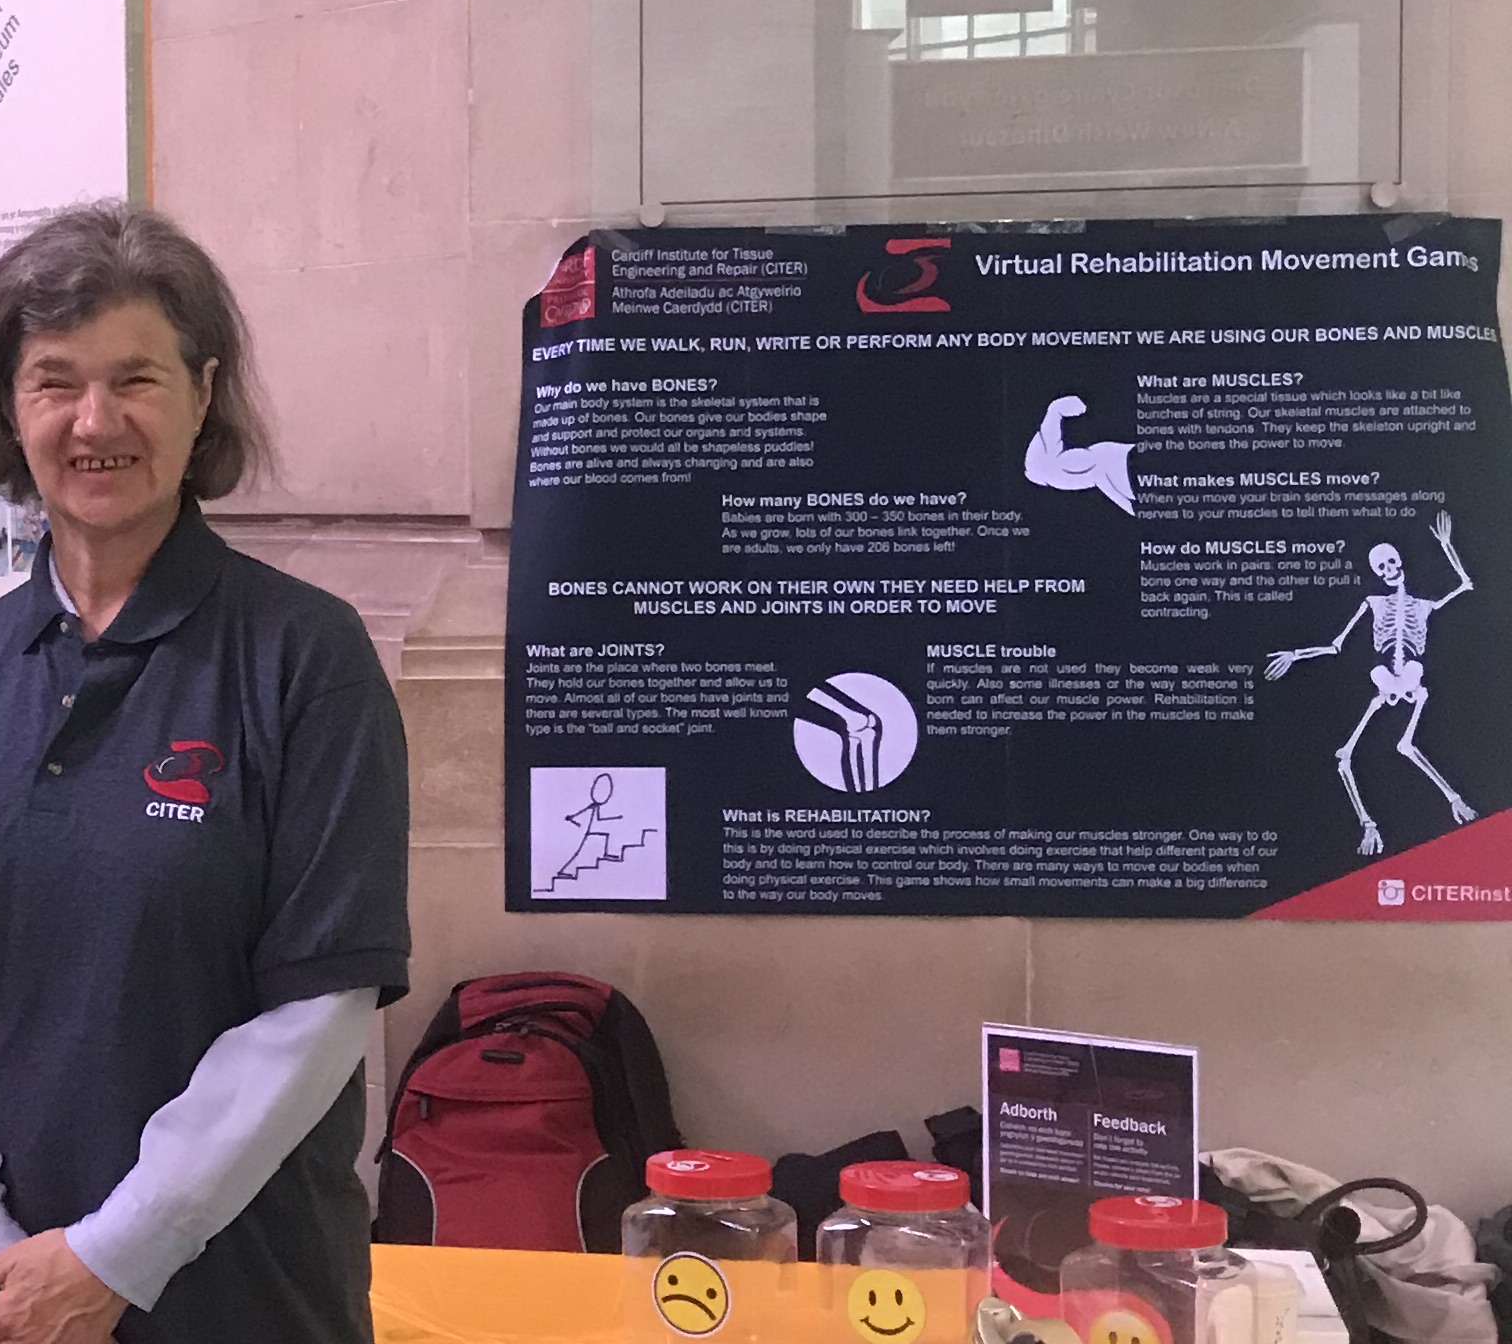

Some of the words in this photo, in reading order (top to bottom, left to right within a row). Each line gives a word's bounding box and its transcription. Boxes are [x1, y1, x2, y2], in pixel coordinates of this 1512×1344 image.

[612, 249, 654, 260] Cardiff
[656, 249, 708, 260] Institute
[712, 248, 730, 259] for
[732, 248, 773, 259] Tissue
[976, 254, 1062, 275] Virtual
[1070, 251, 1252, 273] Rehabilitation
[1260, 249, 1400, 270] Movement
[1407, 245, 1479, 272] Gams
[612, 264, 685, 279] Engineering
[689, 264, 714, 275] and
[716, 263, 758, 277] Repair
[760, 263, 807, 277] (CITER)
[612, 287, 656, 298] Athrofa
[660, 286, 716, 297] Adeiladu
[718, 289, 734, 297] ac
[736, 285, 801, 299] Atgyweirio
[612, 302, 660, 313] Meinwe
[662, 301, 724, 315] Caerdydd
[726, 301, 772, 315] (CITER)
[532, 340, 574, 361] EVERY
[577, 338, 615, 352] TIME
[620, 338, 646, 351] WE
[650, 337, 704, 353] WALK,
[710, 336, 750, 353] RUN,
[756, 335, 810, 349] WRITE
[816, 335, 842, 348] OR
[846, 334, 932, 348] PERFORM
[936, 333, 972, 347] ANY
[978, 333, 1026, 346] BODY
[1032, 331, 1132, 345] MOVEMENT
[1136, 331, 1164, 344] WE
[1168, 330, 1206, 343] ARE
[1210, 329, 1266, 343] USING
[1272, 329, 1310, 342] OUR
[1314, 328, 1378, 341] BONES
[1384, 327, 1422, 340] AND
[549, 582, 608, 595] BONES
[612, 582, 684, 595] CANNOT
[688, 582, 742, 594] WORK
[748, 581, 772, 594] ON
[778, 581, 828, 594] THEIR
[832, 581, 876, 594] OWN
[880, 581, 926, 593] THEY
[930, 581, 978, 593] NEED
[984, 580, 1030, 593] HELP
[1034, 580, 1085, 593] FROM
[634, 601, 716, 614] MUSCLES
[720, 601, 756, 614] AND
[762, 601, 824, 613] JOINTS
[828, 601, 846, 613] IN
[850, 600, 912, 613] ORDER
[918, 600, 942, 613] TO
[946, 600, 996, 613] MOVE
[927, 646, 996, 657] MUSCLE
[1000, 646, 1056, 657] trouble
[927, 664, 936, 673] If
[942, 664, 994, 673] muscles
[1028, 664, 1048, 673] not
[1056, 664, 1088, 673] used
[1094, 664, 1122, 676] they
[1130, 664, 1178, 673] become
[1186, 664, 1220, 673] weak
[1228, 666, 1253, 676] very
[145, 802, 205, 823] CITER
[723, 810, 762, 822] What
[766, 810, 780, 822] is
[784, 810, 930, 822] REHABILITATION?
[1412, 885, 1512, 902] CITERinst
[1000, 1101, 1057, 1122] Adborth
[1093, 1113, 1167, 1136] Feedback
